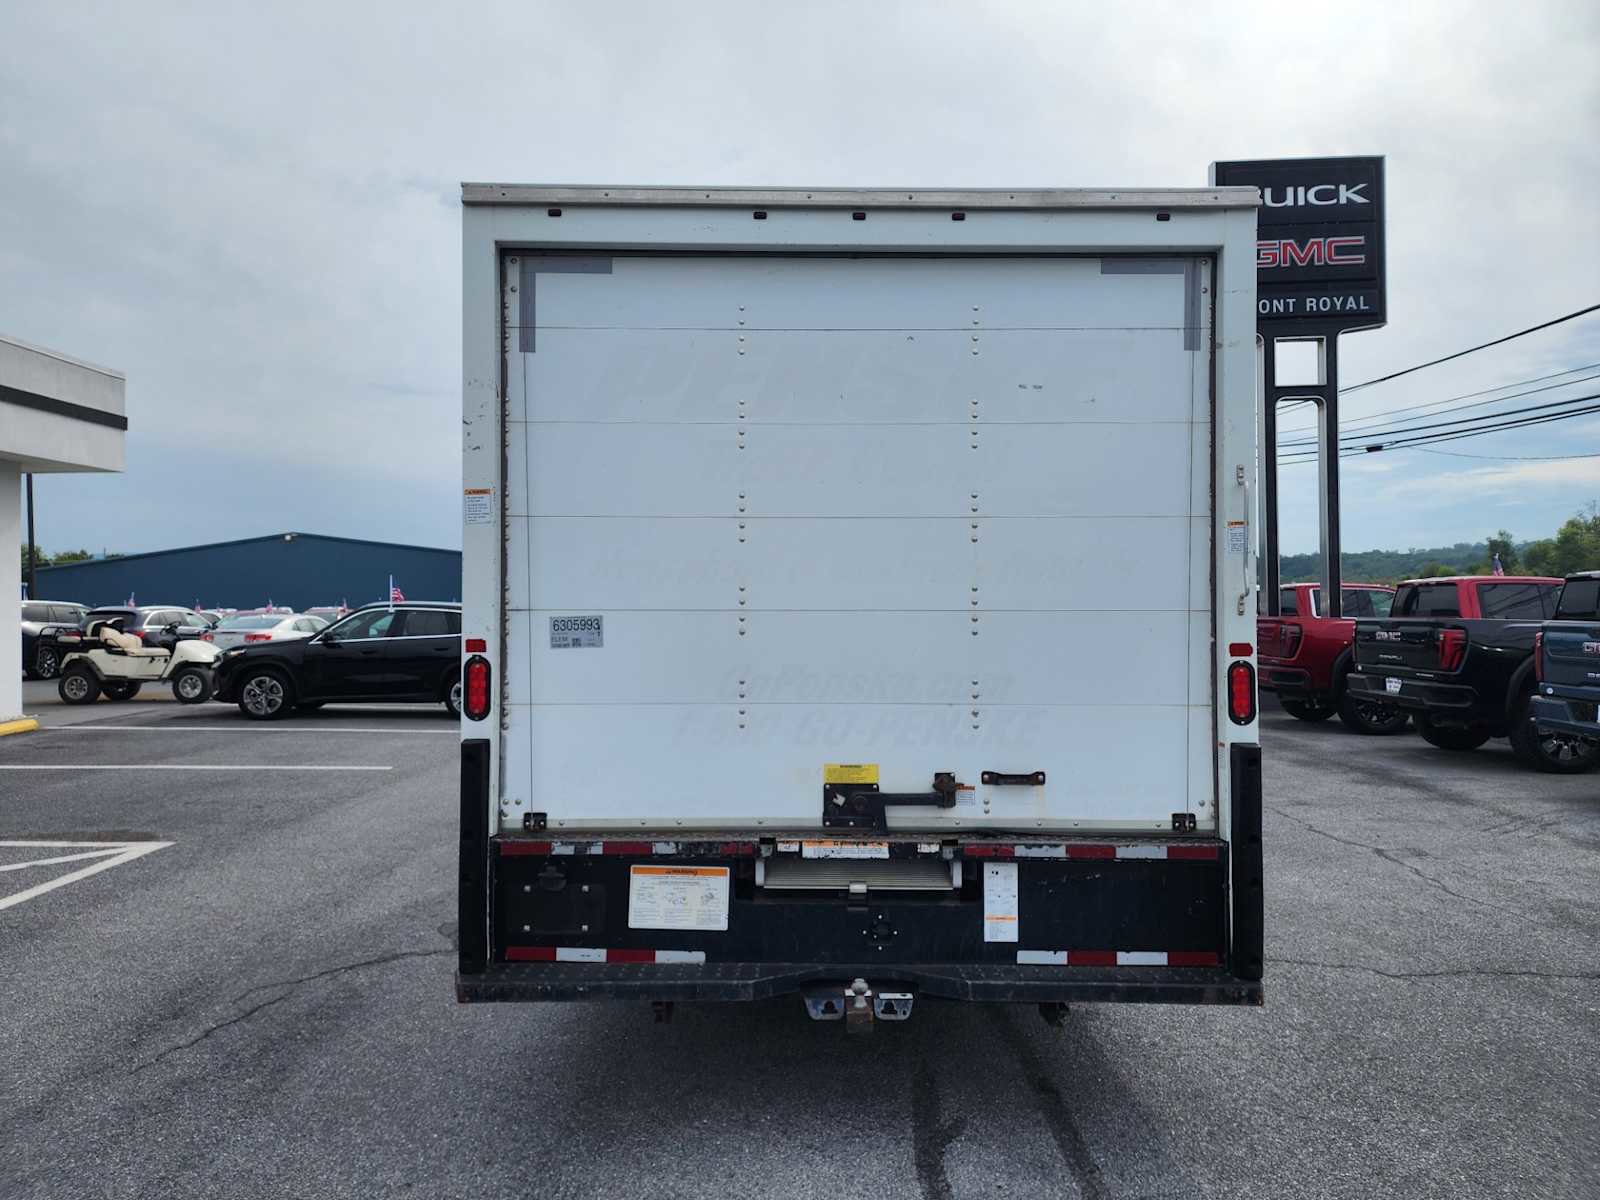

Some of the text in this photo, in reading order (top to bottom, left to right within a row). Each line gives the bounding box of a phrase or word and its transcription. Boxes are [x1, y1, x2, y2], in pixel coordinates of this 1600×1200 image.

[1257, 236, 1366, 268] GMC
[1258, 296, 1370, 314] ONT ROYAL
[552, 618, 601, 632] 6305993
